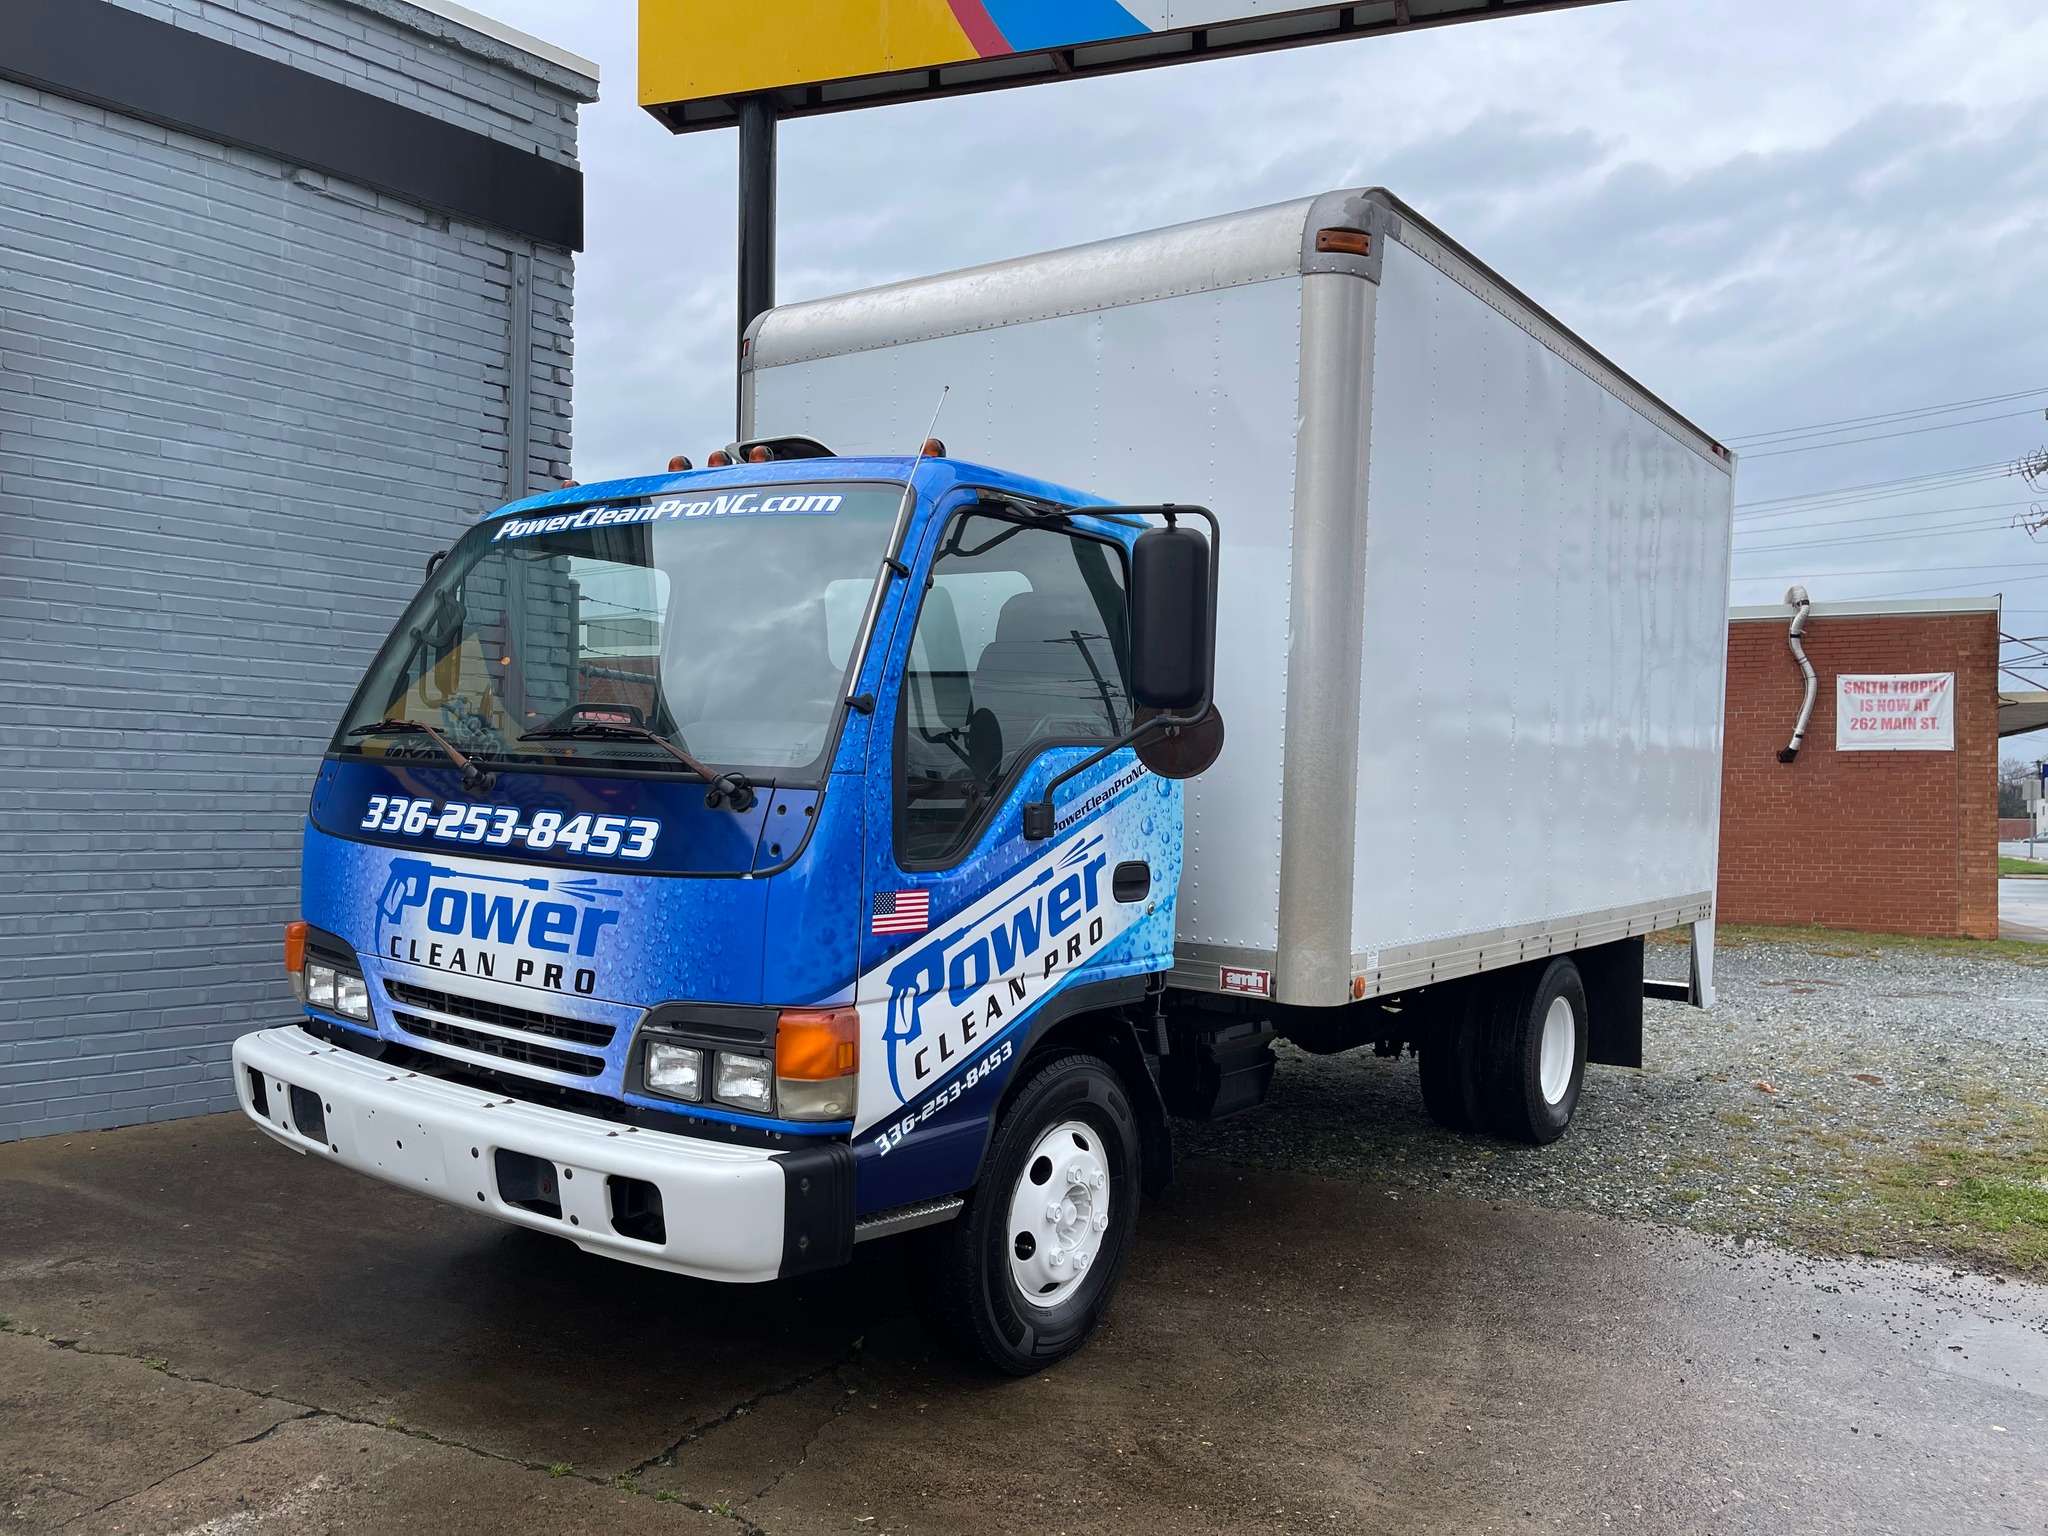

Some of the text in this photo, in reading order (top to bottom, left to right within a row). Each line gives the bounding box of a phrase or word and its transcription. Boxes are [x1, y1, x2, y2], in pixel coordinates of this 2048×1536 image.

[493, 492, 844, 542] PowerCleanProNC.com
[1844, 681, 1888, 694] SMITH
[1860, 698, 1930, 712] IS NOW AT
[1850, 717, 1940, 730] 262 MAIN ST.
[361, 796, 660, 858] 336-253-8453
[1054, 764, 1148, 832] PowerCleanProNC.
[382, 858, 620, 957] Power
[390, 935, 596, 994] CLEAN PRO
[884, 852, 1106, 1046] Power
[914, 916, 1103, 1081] CLEAN PRO
[1226, 972, 1263, 988] amh
[874, 1041, 1013, 1158] 336-253-8453
